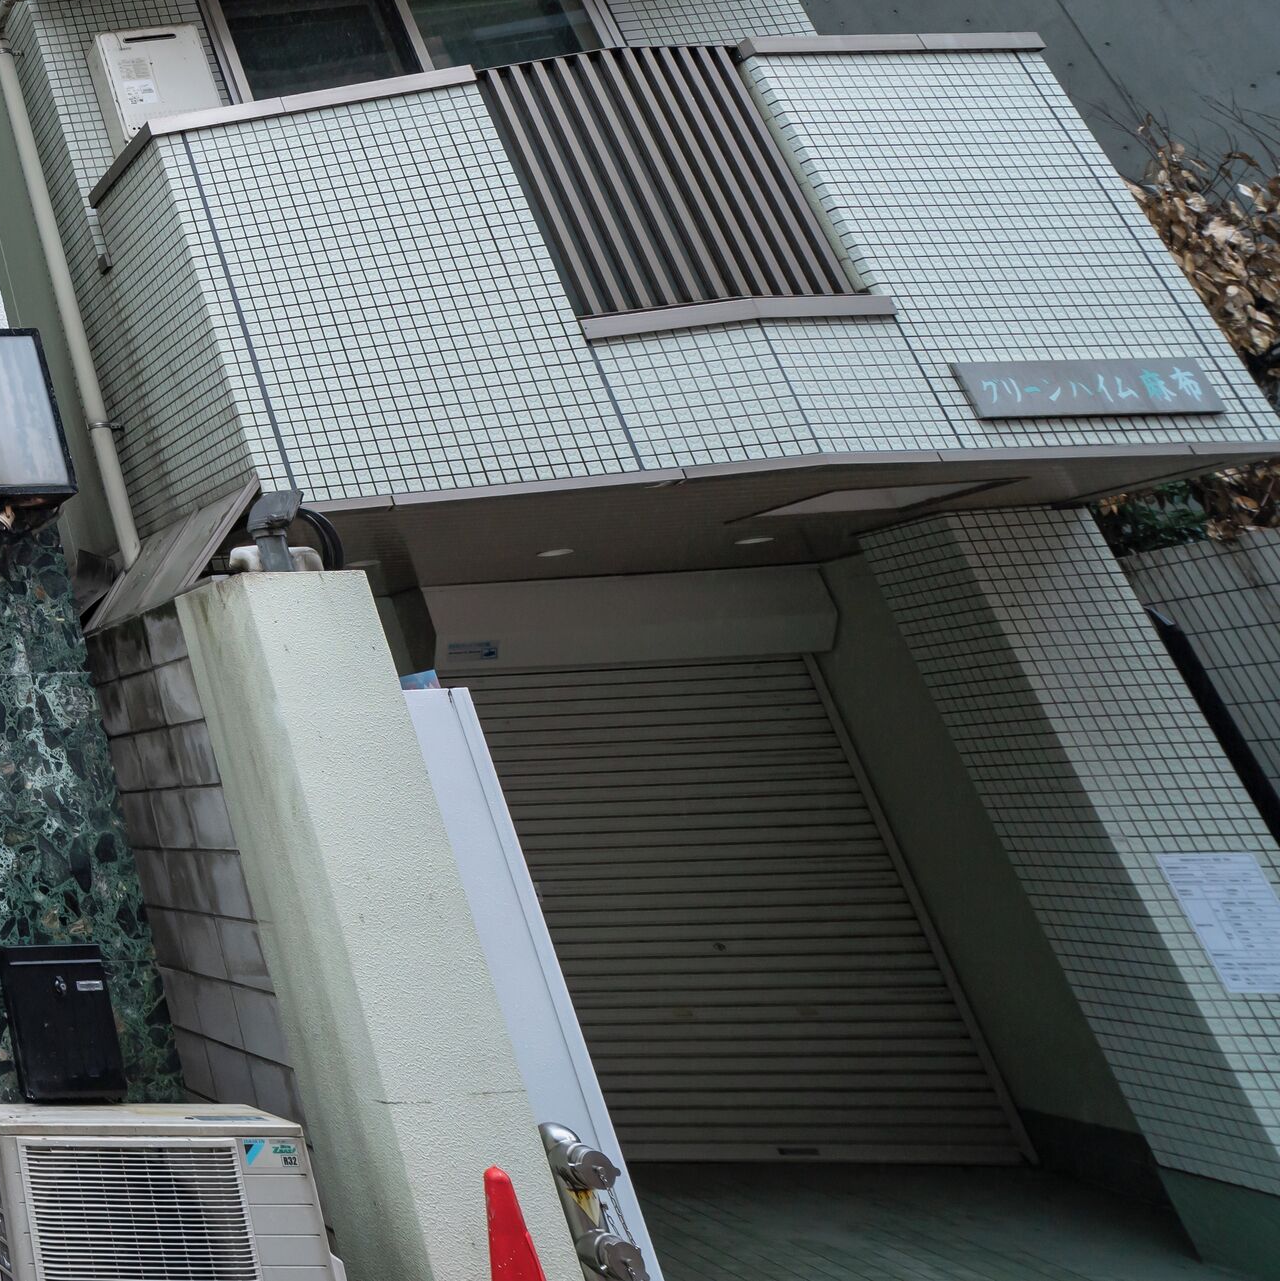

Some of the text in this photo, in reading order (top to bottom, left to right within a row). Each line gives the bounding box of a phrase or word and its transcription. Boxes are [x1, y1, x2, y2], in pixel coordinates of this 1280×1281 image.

[981, 367, 1204, 403] グリーンハイム麻布
[282, 1156, 298, 1166] R32
